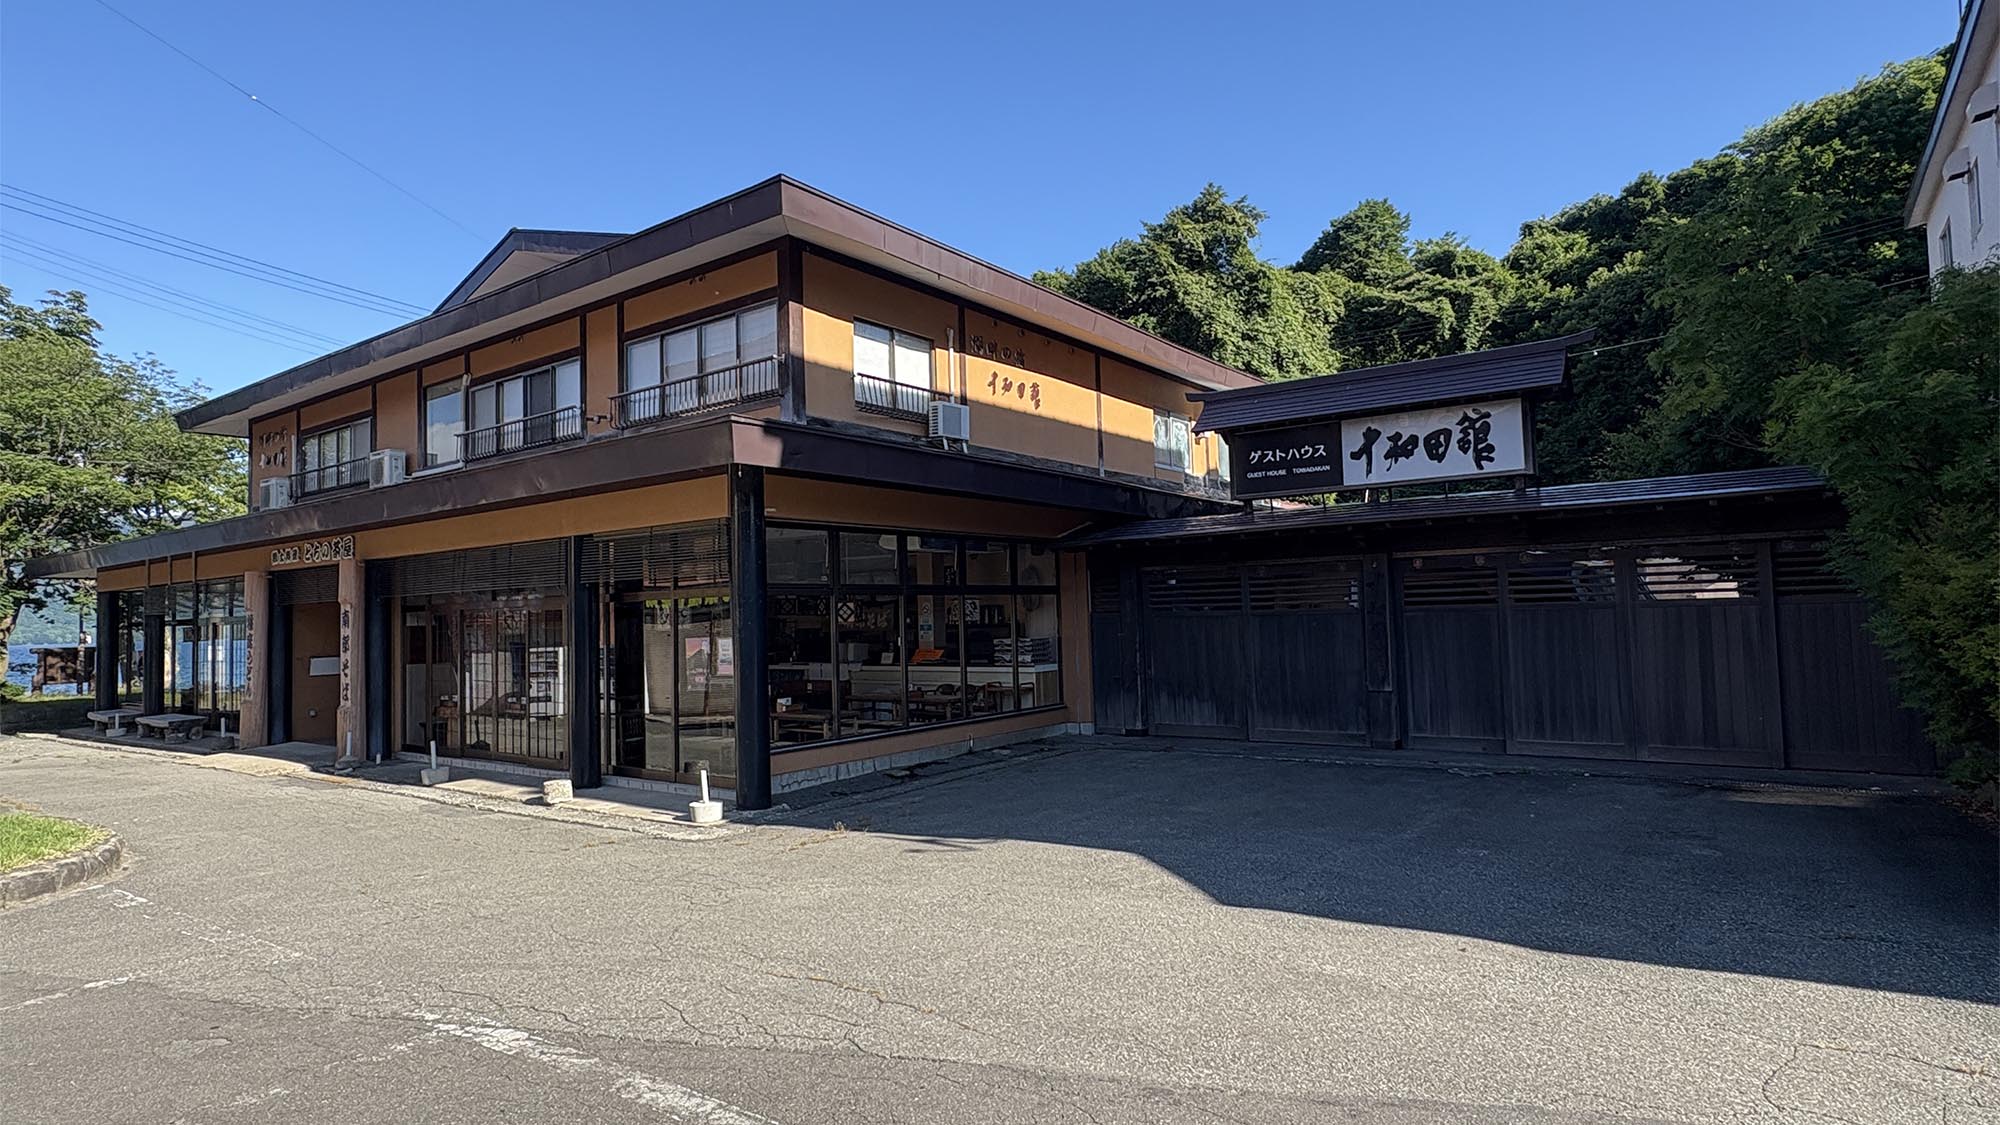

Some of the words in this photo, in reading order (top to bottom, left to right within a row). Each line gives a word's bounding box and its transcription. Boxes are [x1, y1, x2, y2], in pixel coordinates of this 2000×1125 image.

[1249, 444, 1327, 465] ゲストハウス
[1246, 471, 1266, 479] GUEST
[1267, 469, 1287, 477] HOUSE
[1292, 465, 1331, 475] TOWADAKAN
[303, 535, 353, 562] とちの茶屋
